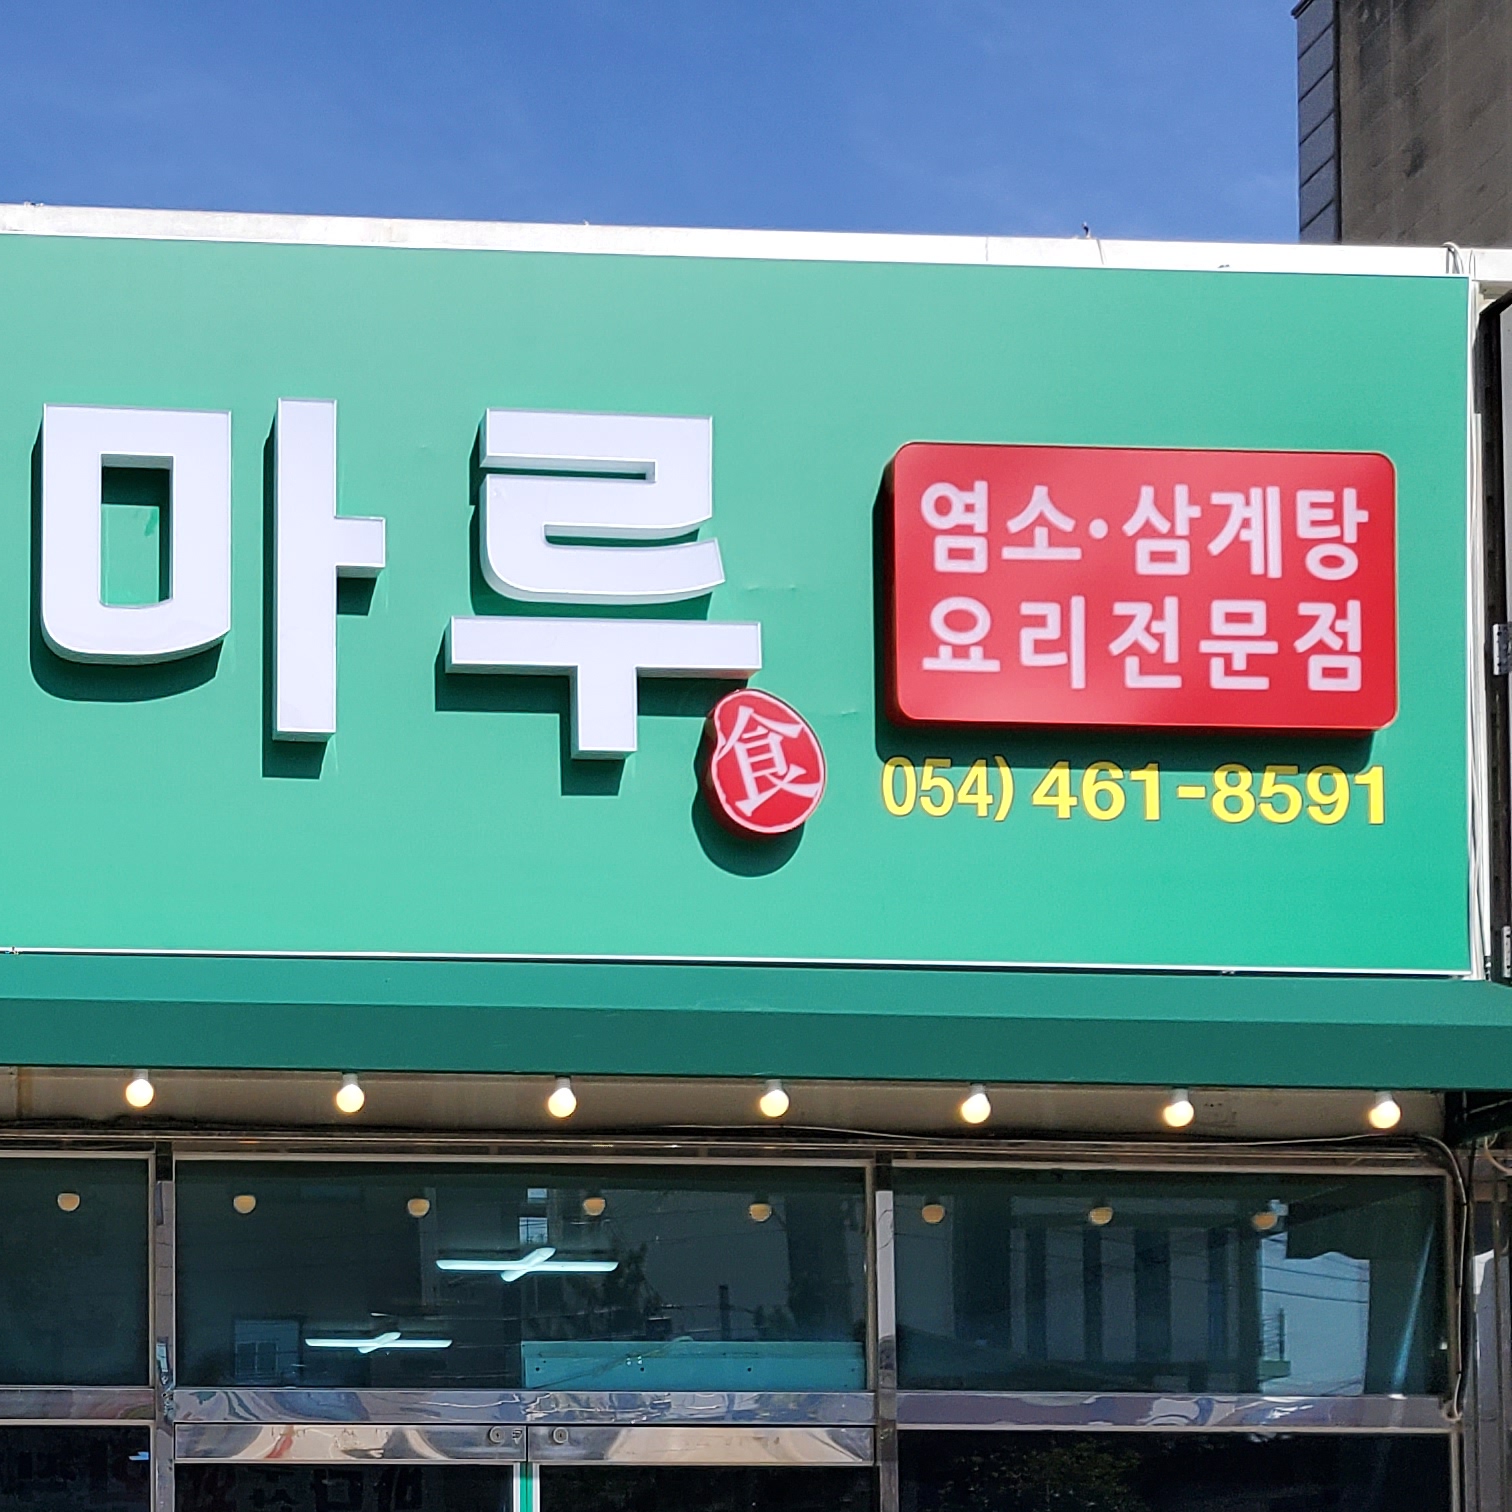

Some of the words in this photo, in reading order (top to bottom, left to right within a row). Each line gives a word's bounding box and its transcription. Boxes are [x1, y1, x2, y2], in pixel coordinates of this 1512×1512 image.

[920, 479, 1369, 581] 염소·삼계탕
[922, 595, 1363, 693] 요리전문점
[714, 703, 821, 818] 食
[880, 755, 1015, 822] 054)
[1032, 760, 1386, 826] 461-8591
